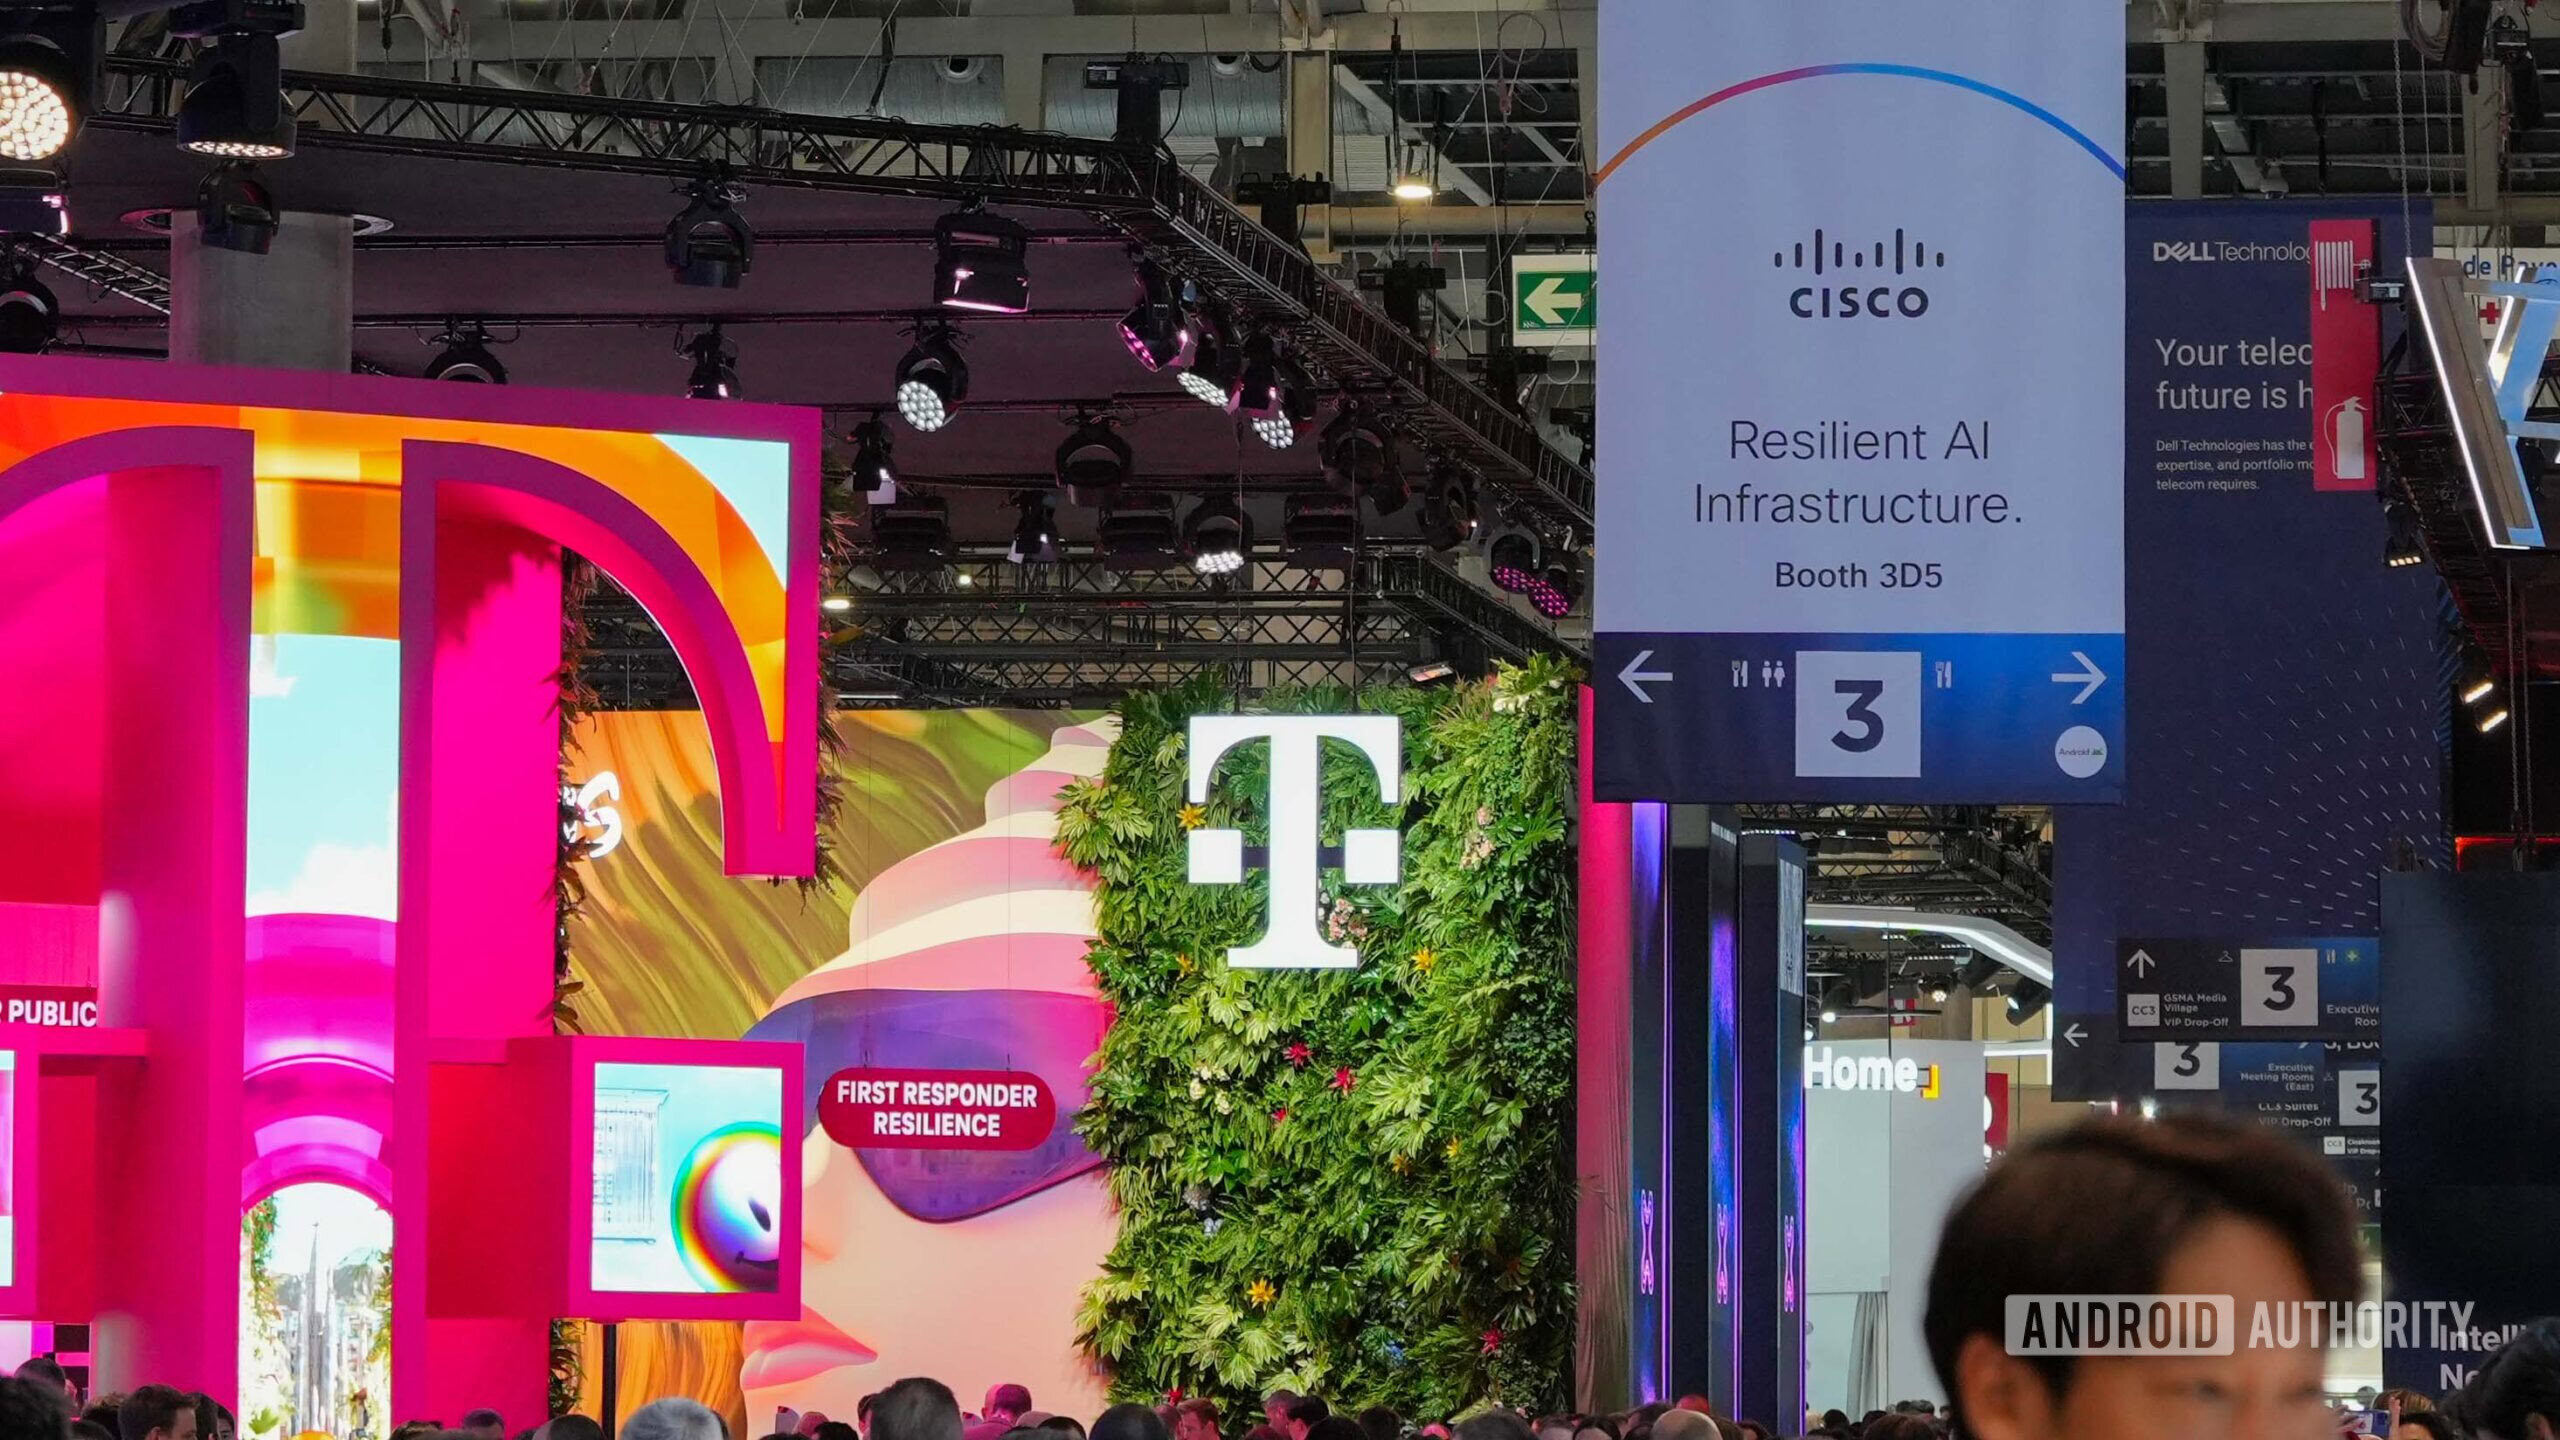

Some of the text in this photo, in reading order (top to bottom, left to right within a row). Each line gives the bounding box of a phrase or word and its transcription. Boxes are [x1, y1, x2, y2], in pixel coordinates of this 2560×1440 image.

[2153, 241, 2312, 264] DELL Technolo
[1790, 287, 1929, 318] CISCO
[2155, 336, 2313, 366] Your telec
[2156, 380, 2251, 409] future
[2262, 381, 2287, 409] is
[1730, 420, 1989, 460] Resilient AI
[2156, 440, 2178, 451] Dell
[2181, 440, 2260, 453] Technologies
[2263, 440, 2285, 451] has
[2287, 440, 2306, 451] the
[2156, 459, 2214, 473] expertise,
[2217, 459, 2240, 471] and
[2243, 458, 2294, 473] portfolio
[2156, 479, 2260, 492] telecom requires.
[1696, 483, 2022, 523] Infrastructure.
[1775, 562, 1943, 588] Booth 3D5
[1831, 679, 1884, 753] 3
[1189, 715, 1401, 968] T
[2164, 993, 2227, 1002] GSMA Media
[2263, 966, 2295, 1011] 3
[8, 999, 97, 1027] PUBLIC
[2131, 1006, 2156, 1016] CC3
[2164, 1004, 2198, 1013] Village
[2355, 1017, 2377, 1026] Roo
[2164, 1018, 2229, 1028] VIP Drop-Off
[1804, 1046, 1918, 1092] Home
[2173, 1042, 2200, 1077] 3
[2268, 1063, 2314, 1072] Executive
[2240, 1073, 2314, 1082] Meeting Rooms
[2285, 1083, 2314, 1092] (East)
[837, 1080, 1038, 1107] FIRST RESPONDER
[2355, 1083, 2379, 1115] 3
[873, 1111, 1000, 1137] RESILIENCE
